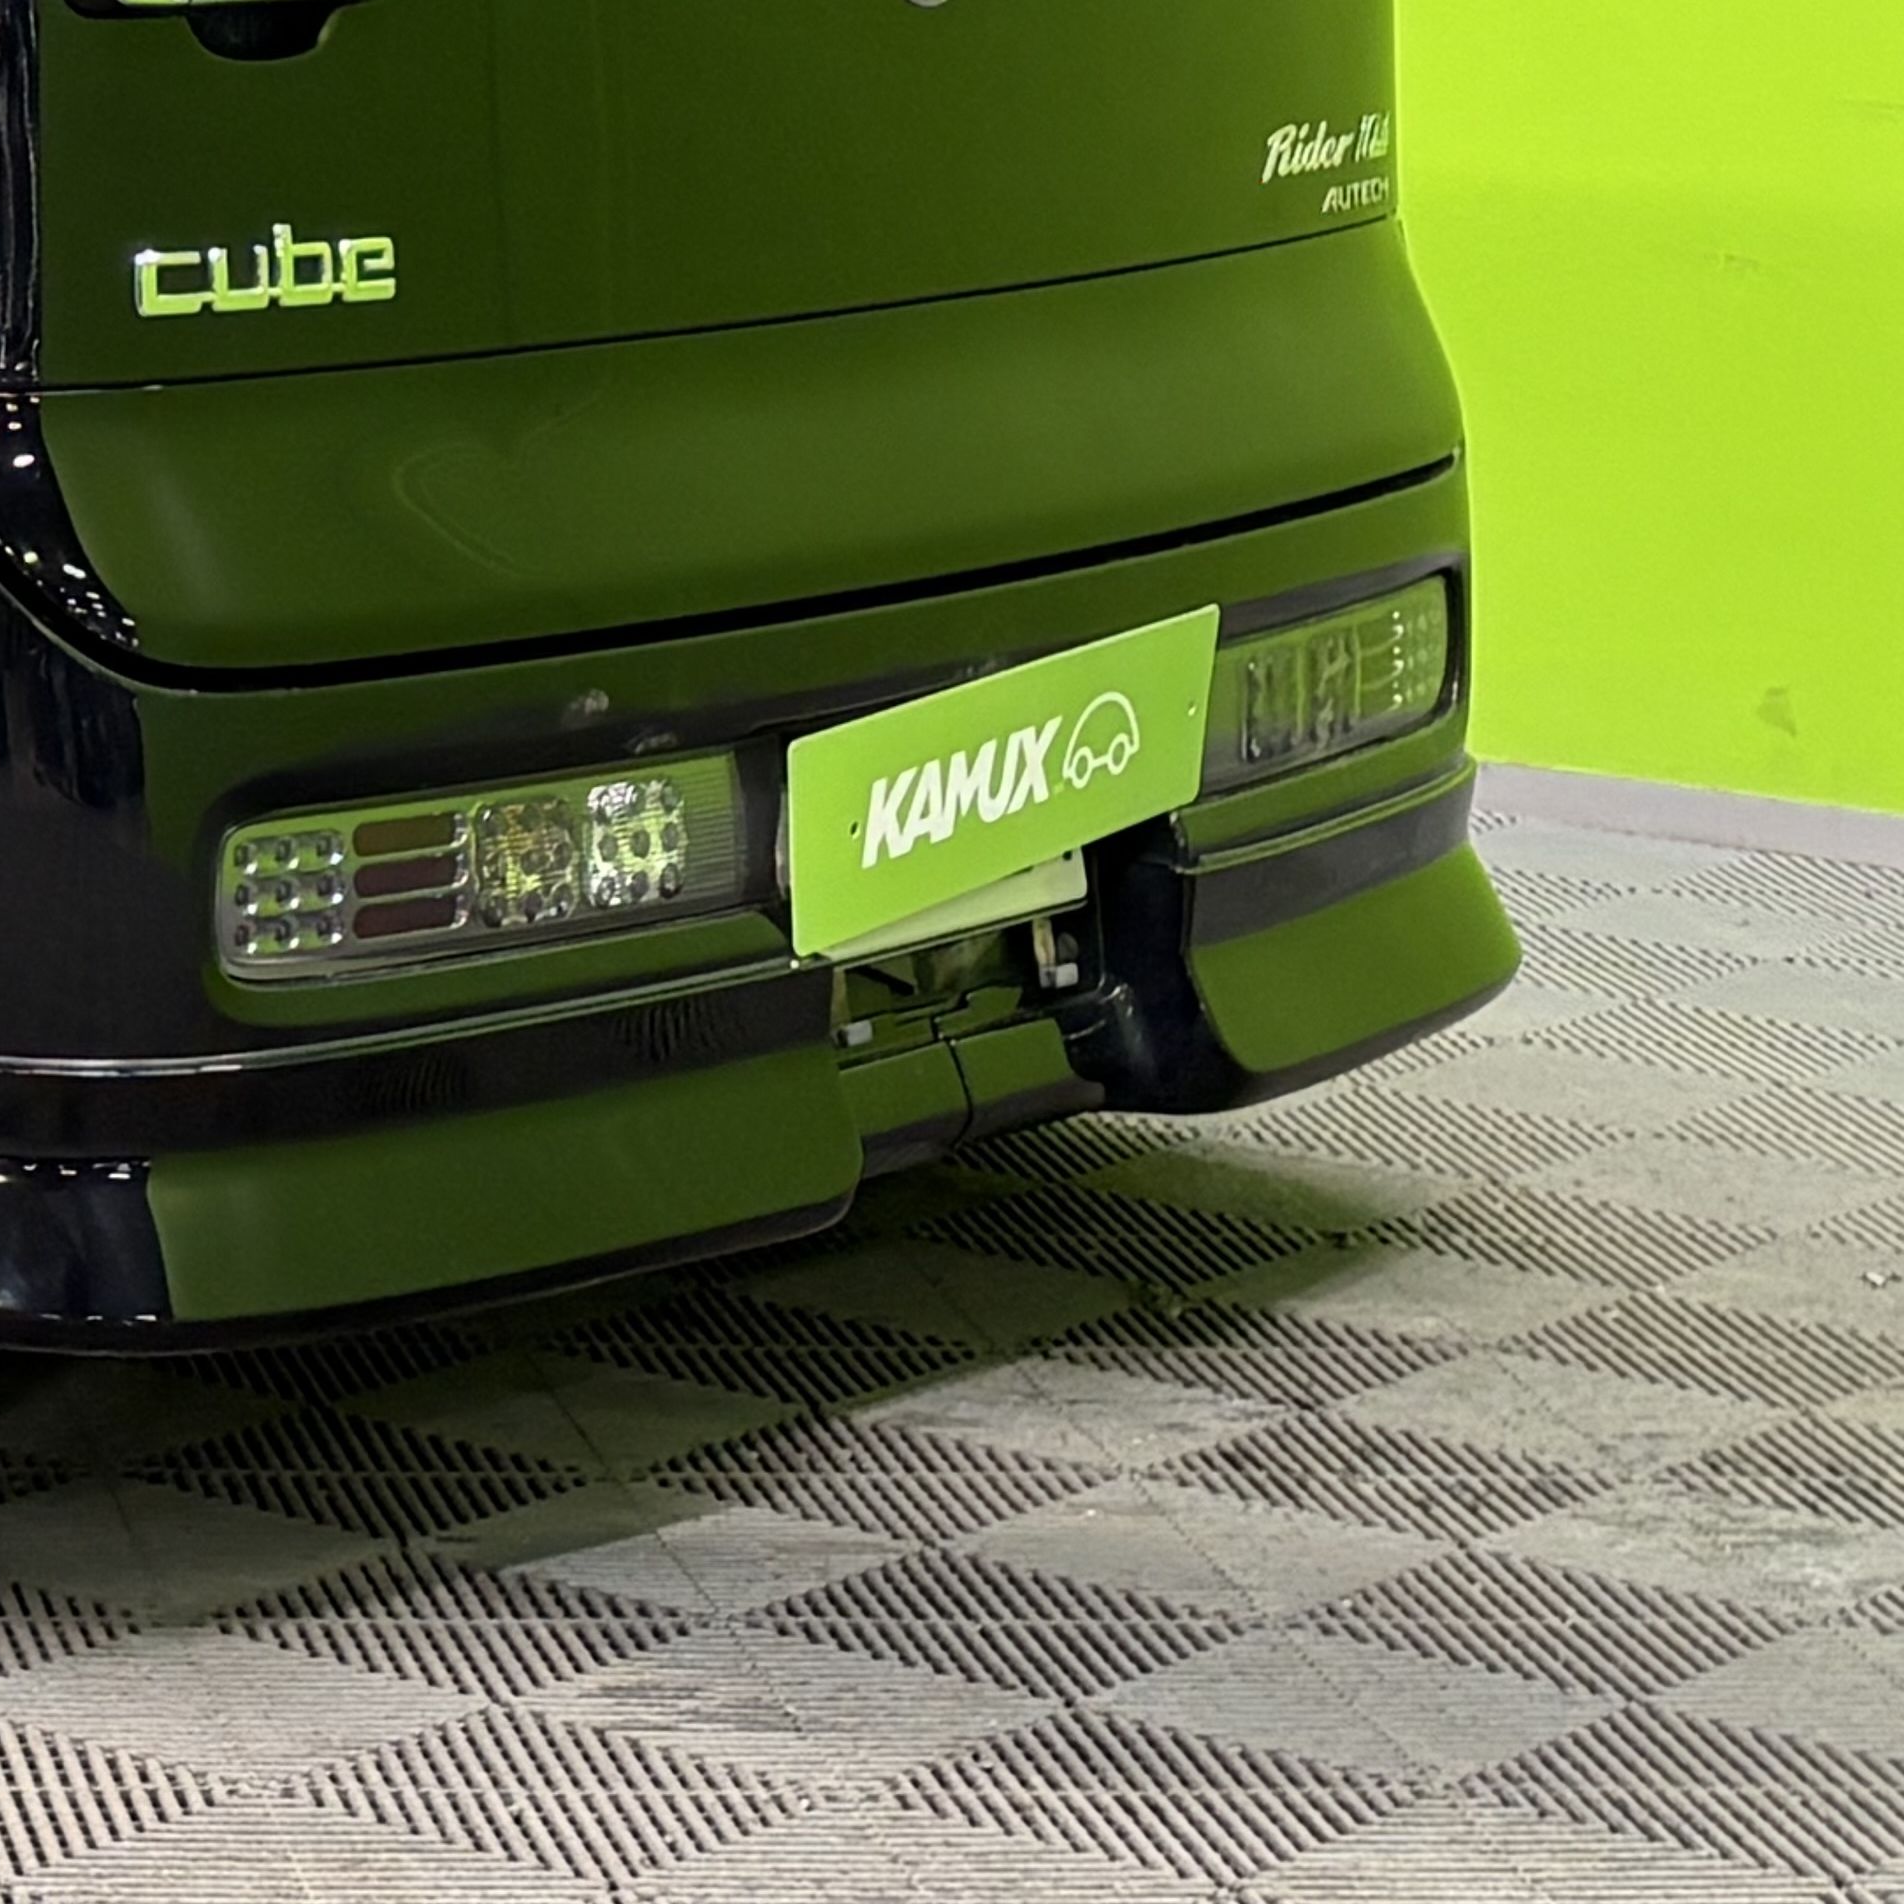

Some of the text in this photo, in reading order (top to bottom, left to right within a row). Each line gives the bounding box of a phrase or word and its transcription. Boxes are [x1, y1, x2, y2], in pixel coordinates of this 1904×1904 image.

[1261, 120, 1355, 184] Rider
[134, 222, 397, 317] cube
[860, 714, 1064, 869] KAMUX
